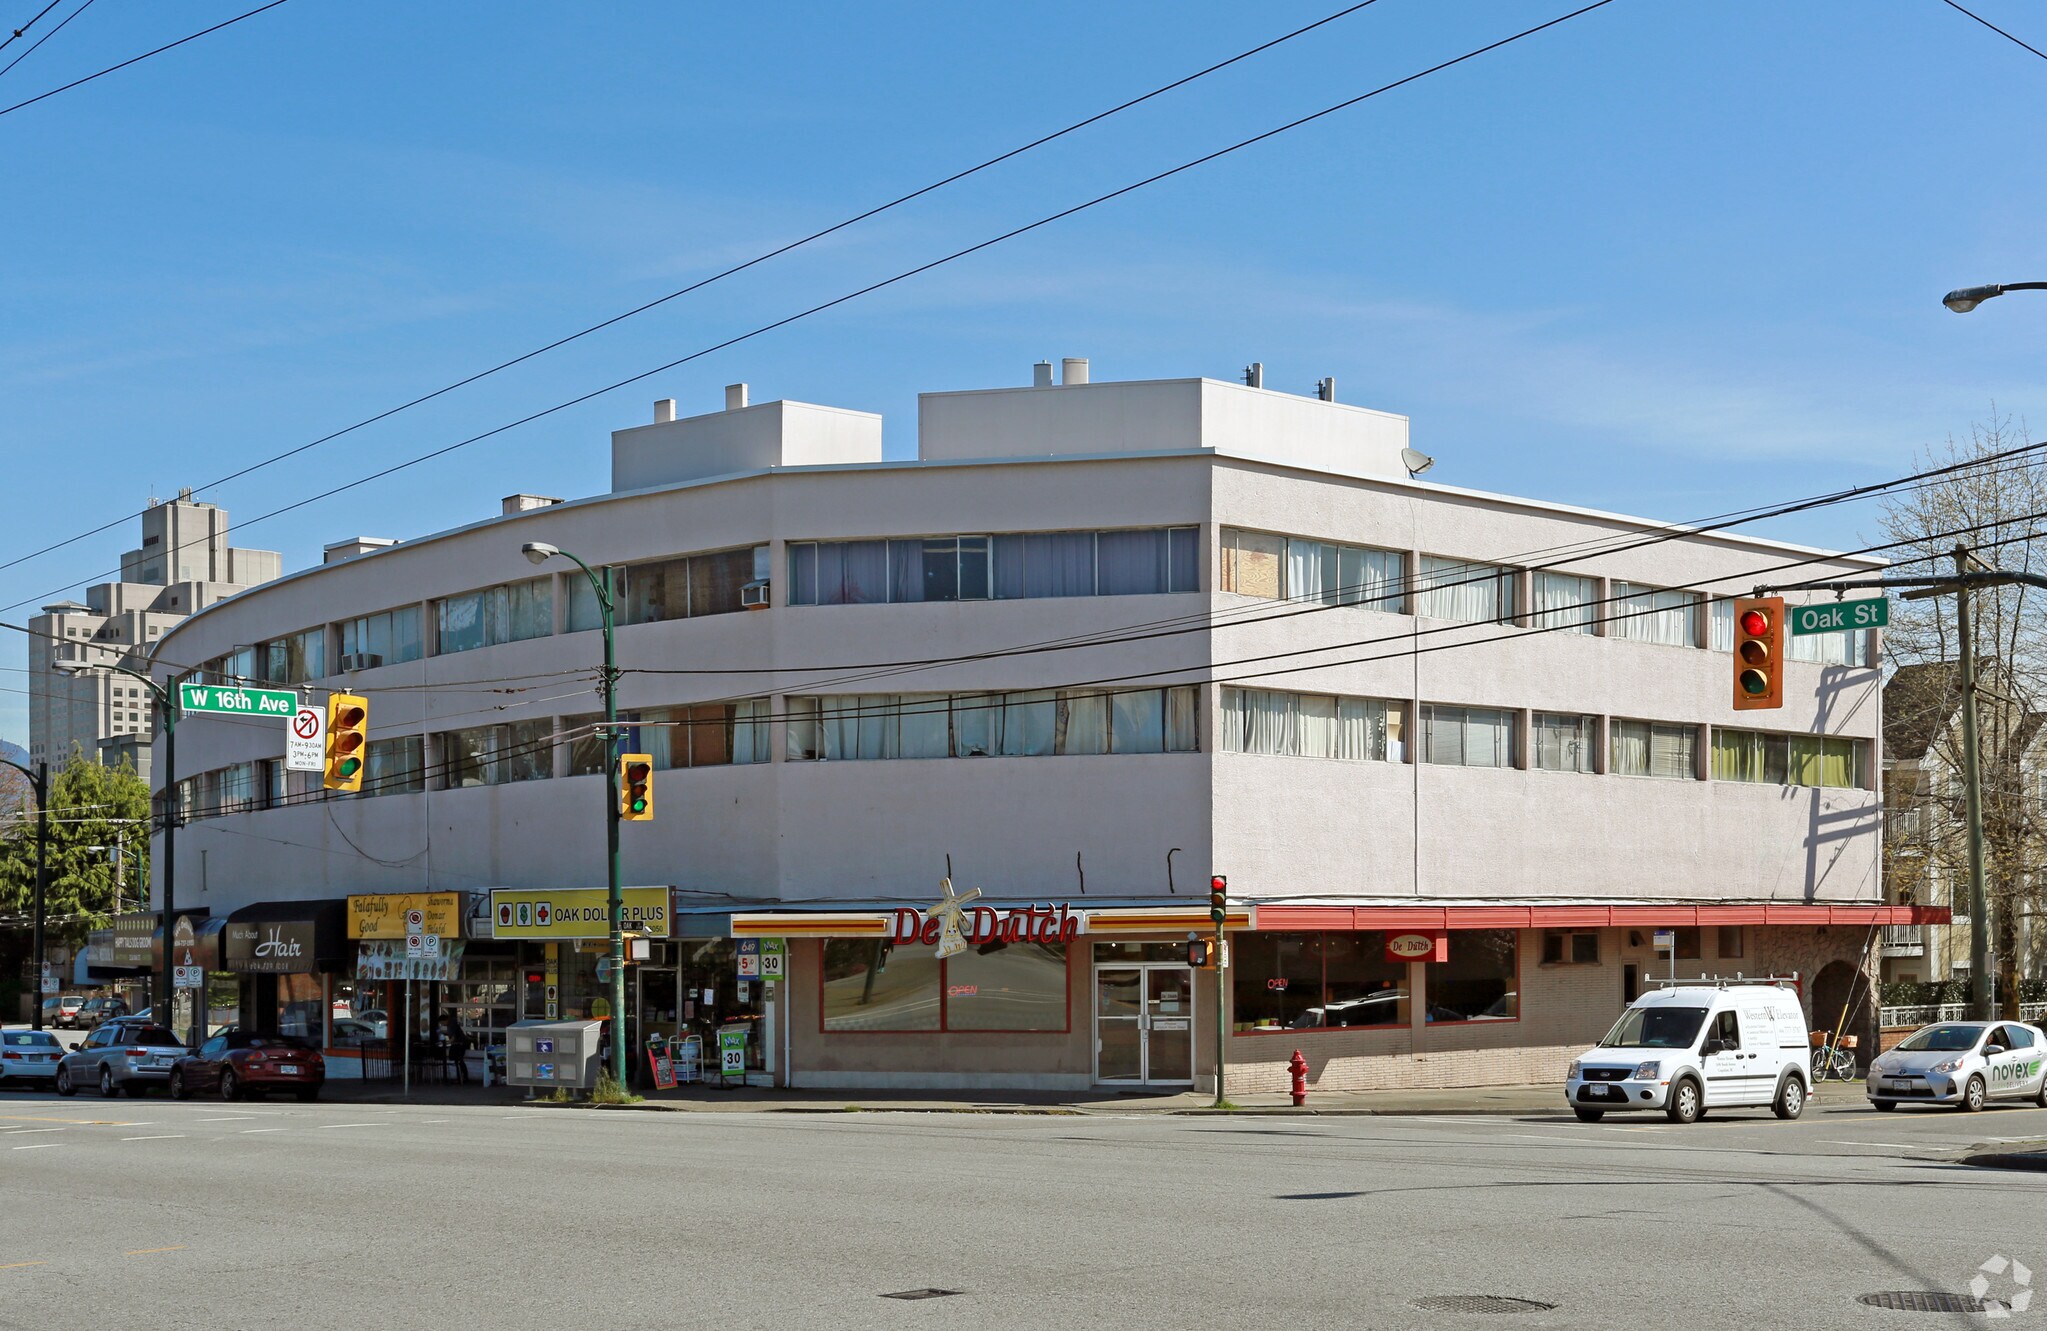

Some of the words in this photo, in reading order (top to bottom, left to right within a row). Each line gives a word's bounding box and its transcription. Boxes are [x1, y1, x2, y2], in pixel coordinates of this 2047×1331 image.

[1802, 608, 1844, 630] Oak
[1854, 604, 1878, 625] St
[190, 689, 208, 706] W
[215, 691, 252, 710] 16th
[258, 694, 289, 712] Ave
[353, 896, 389, 917] Falafully
[555, 908, 579, 921] OAK
[583, 908, 629, 921] DOLR
[632, 906, 663, 921] PLUS
[359, 917, 380, 937] Good
[892, 907, 940, 945] De
[971, 902, 1079, 945] Dutch
[244, 930, 258, 939] About
[255, 925, 302, 957] Hair
[1392, 941, 1403, 952] De
[1407, 940, 1429, 952] Dutch
[948, 985, 978, 997] OPEN
[1267, 978, 1288, 989] OPEN
[1992, 1062, 2029, 1082] novex
